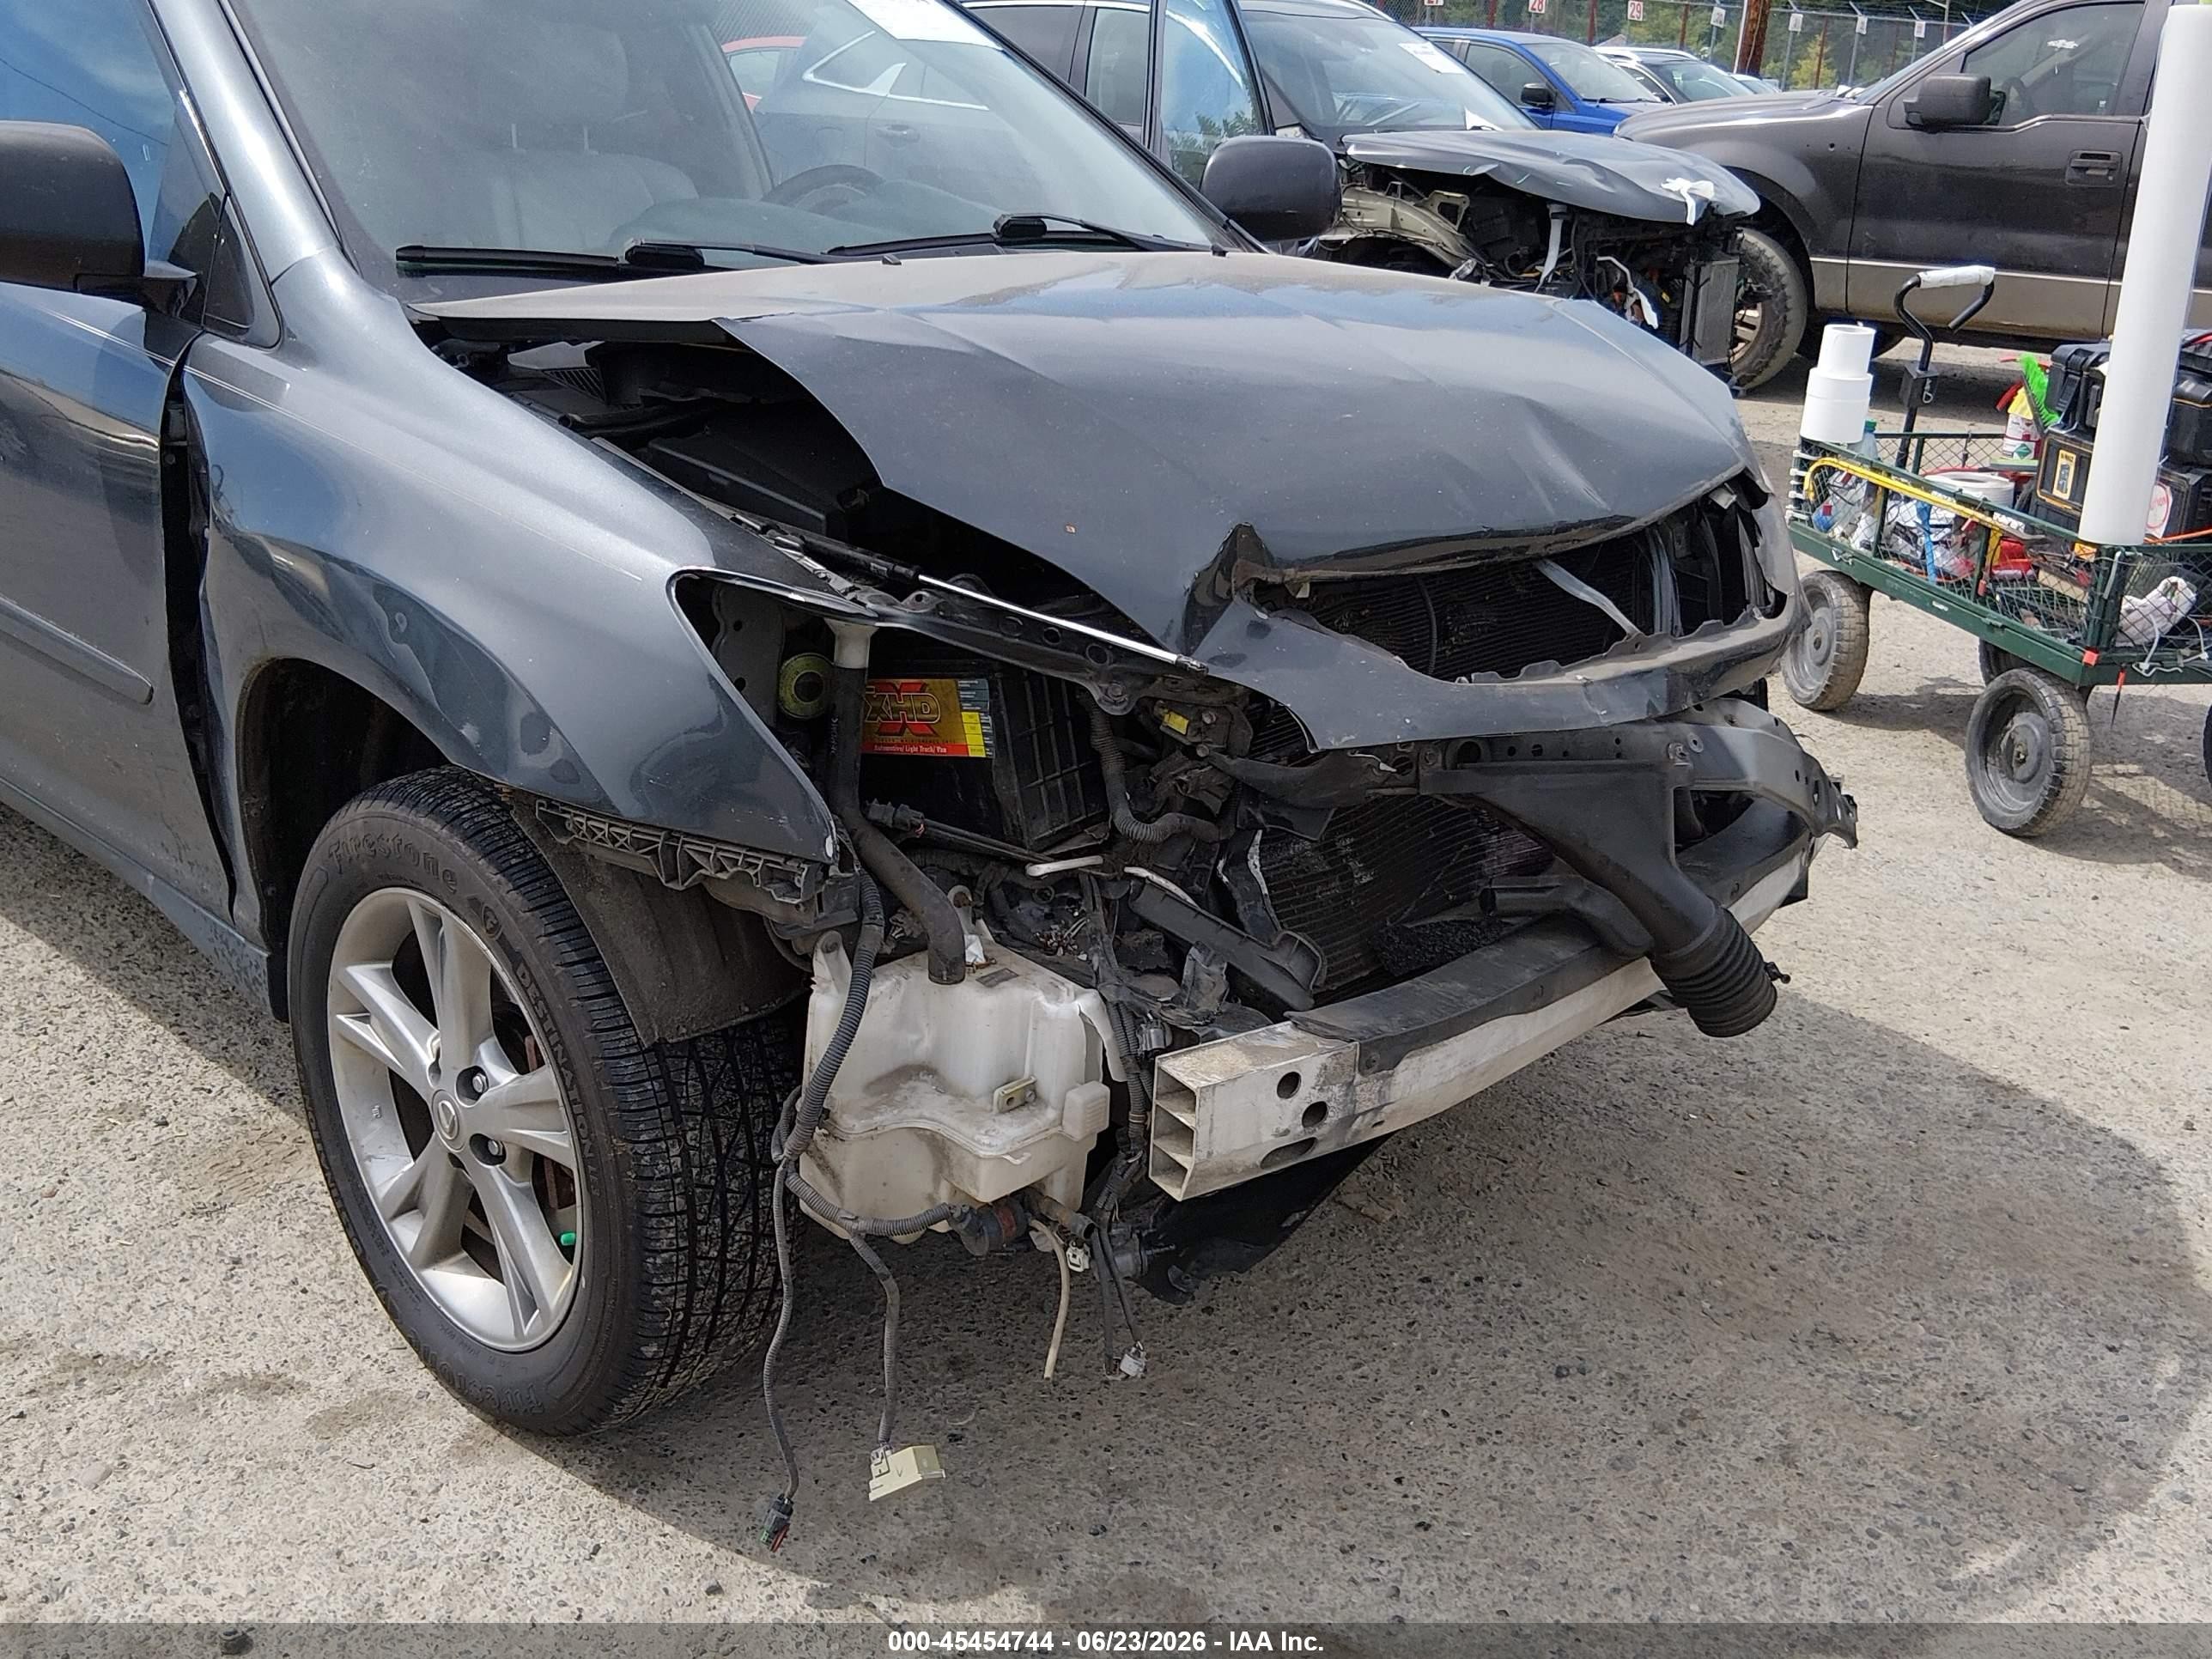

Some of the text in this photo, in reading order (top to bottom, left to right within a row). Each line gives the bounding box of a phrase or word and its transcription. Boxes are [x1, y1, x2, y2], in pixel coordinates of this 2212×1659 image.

[1530, 0, 1544, 11] 28
[1629, 4, 1641, 20] 29
[866, 692, 941, 724] XHD
[905, 744, 919, 753] Light
[328, 833, 458, 895] Firestone
[515, 960, 595, 1158] DESTINATION
